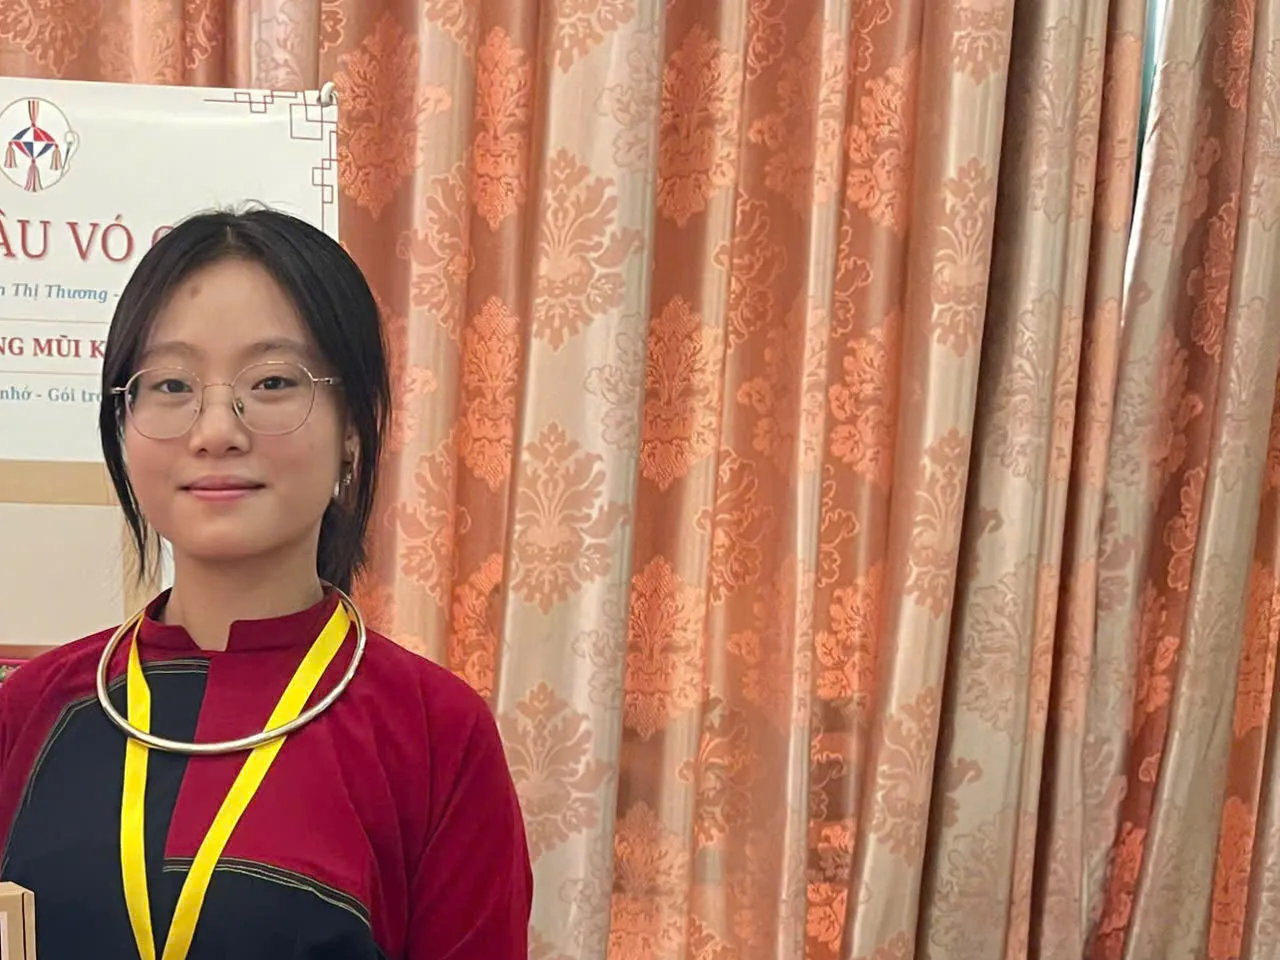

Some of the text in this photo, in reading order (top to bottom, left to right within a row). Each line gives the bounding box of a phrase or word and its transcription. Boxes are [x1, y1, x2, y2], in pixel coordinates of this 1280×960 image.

[66, 213, 134, 262] VÓ
[12, 283, 39, 300] Thị
[45, 284, 108, 303] Thương
[33, 334, 81, 359] MŨI
[48, 386, 75, 402] Gói
